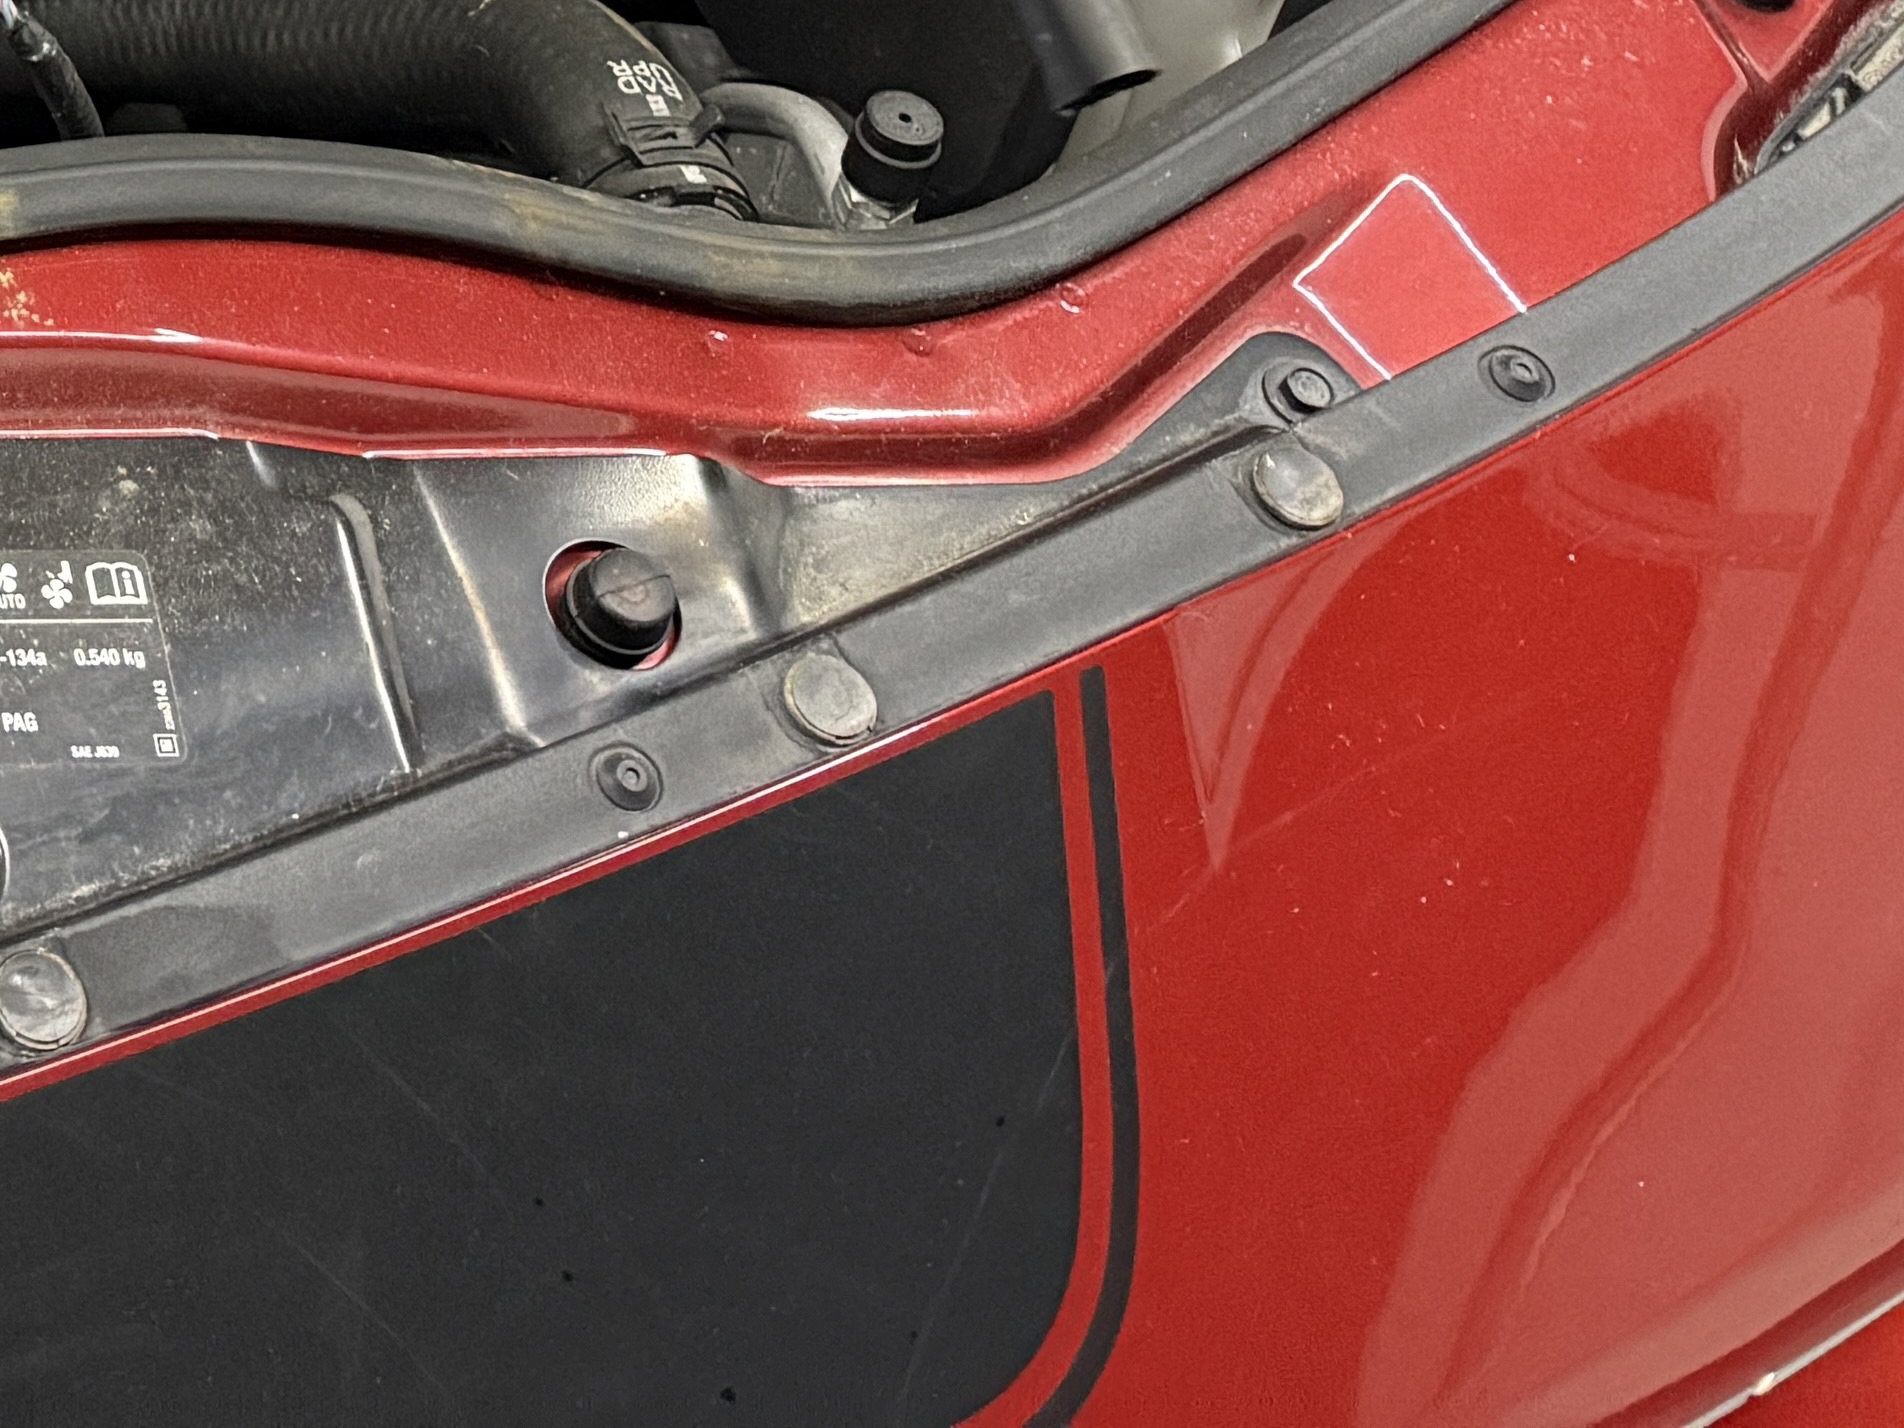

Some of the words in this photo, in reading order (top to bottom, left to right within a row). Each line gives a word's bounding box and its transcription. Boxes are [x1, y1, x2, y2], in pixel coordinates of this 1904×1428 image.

[73, 648, 120, 668] 0.540
[122, 648, 147, 670] kg
[1, 712, 39, 734] PAG
